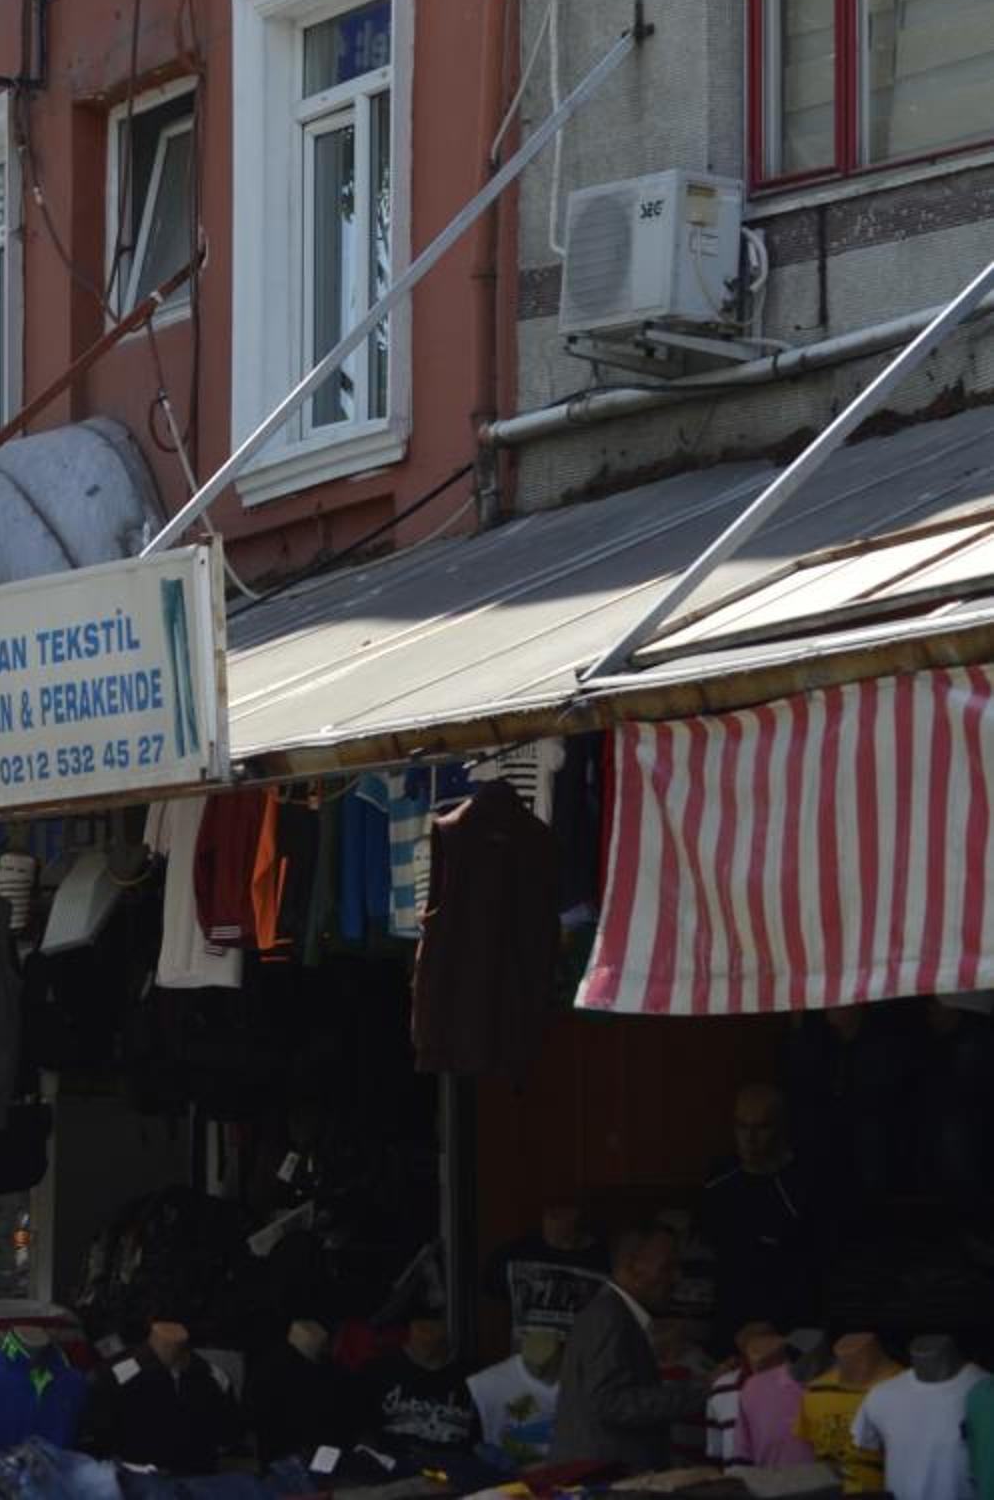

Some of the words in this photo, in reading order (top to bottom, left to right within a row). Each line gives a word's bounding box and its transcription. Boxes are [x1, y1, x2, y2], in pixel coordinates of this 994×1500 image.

[35, 608, 141, 667] TEKSTİL
[20, 688, 35, 730] &
[39, 667, 164, 727] PERAKENDE
[0, 750, 51, 787] 0212
[57, 744, 96, 778] 532
[104, 736, 130, 769] 45
[137, 733, 166, 766] 27
